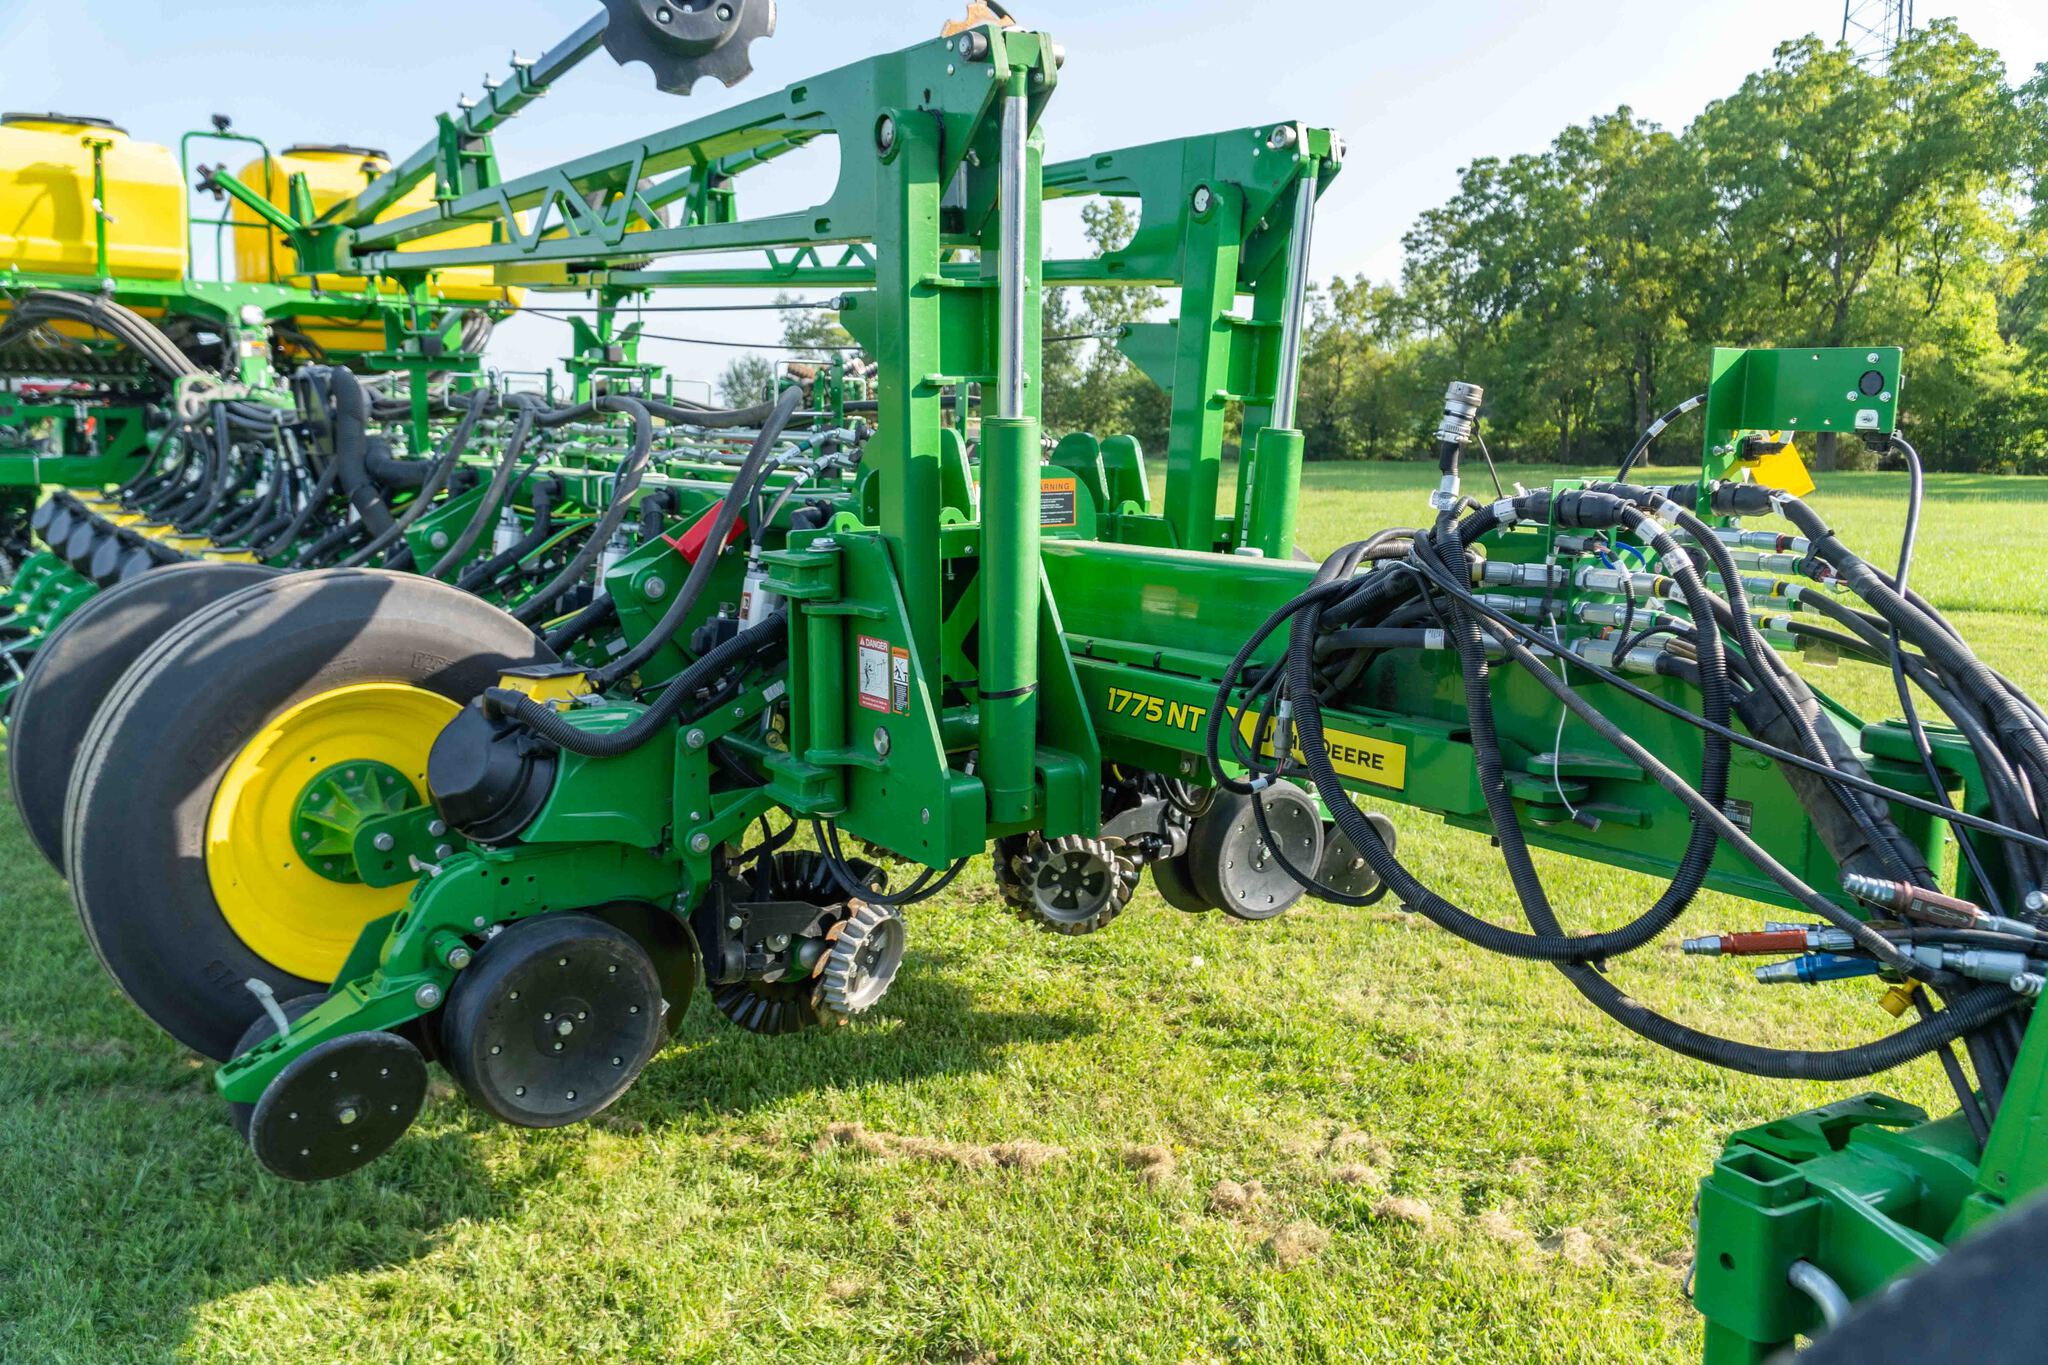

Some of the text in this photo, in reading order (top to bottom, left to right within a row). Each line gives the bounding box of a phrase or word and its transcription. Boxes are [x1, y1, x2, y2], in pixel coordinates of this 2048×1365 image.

[865, 638, 888, 652] DANGER
[1107, 687, 1207, 732] 1775 NT
